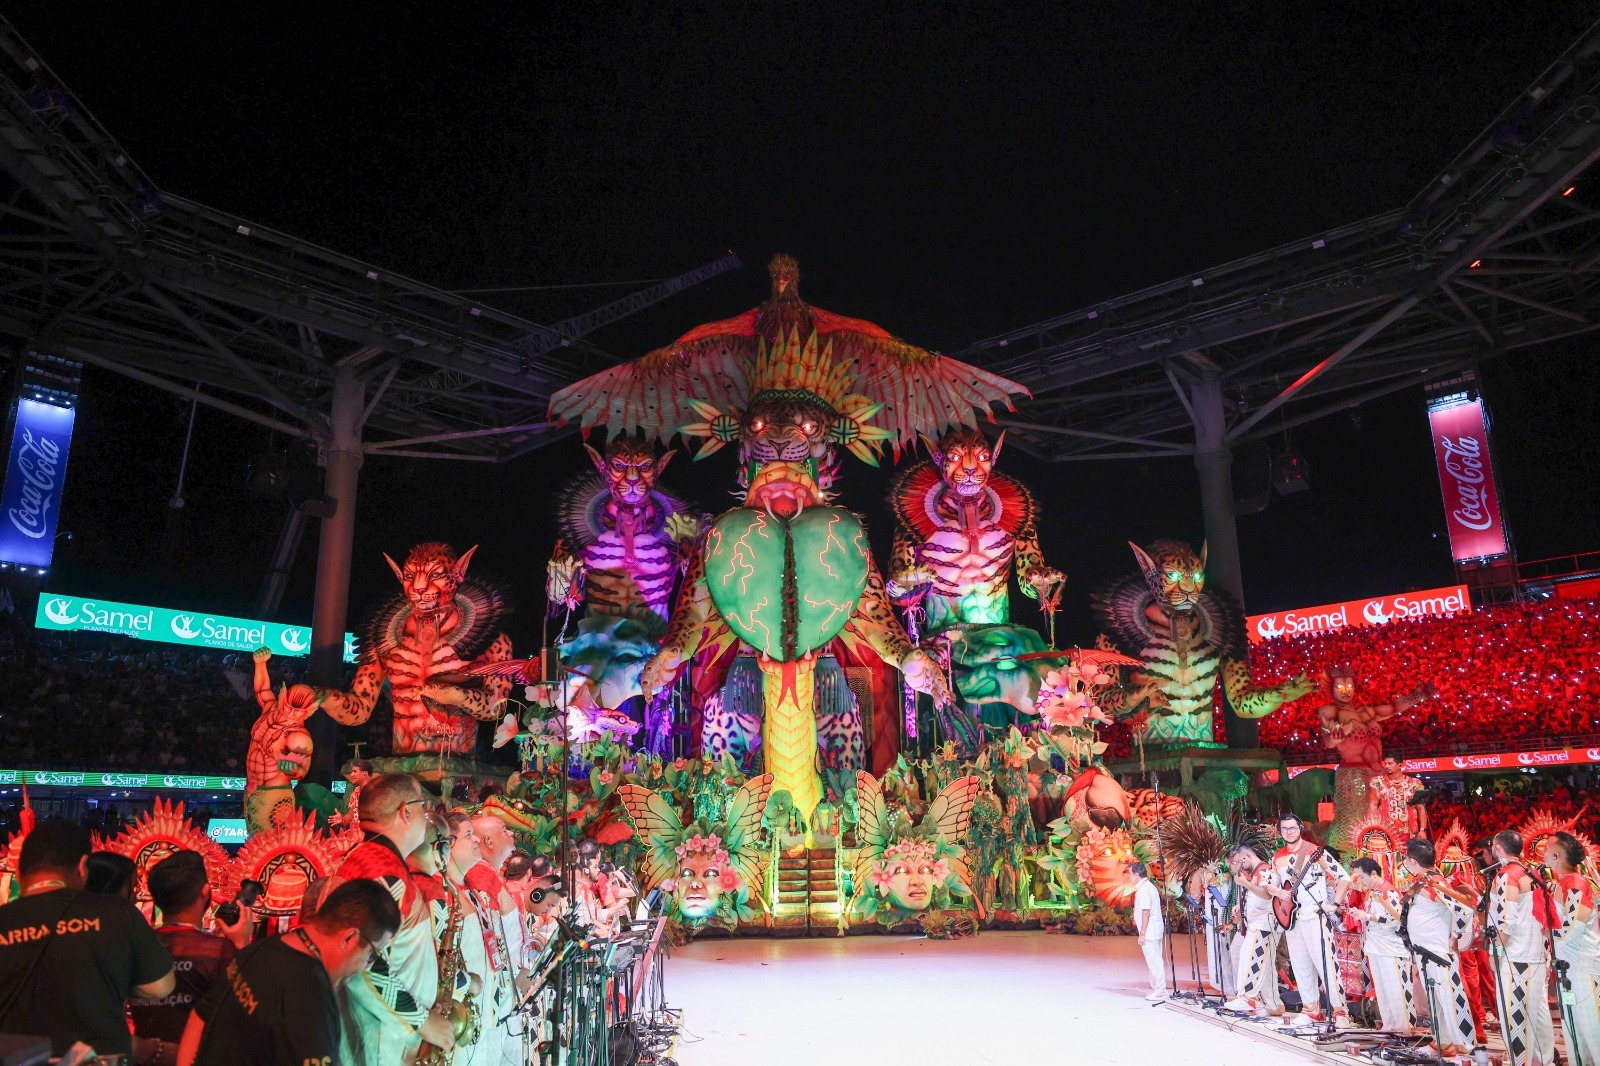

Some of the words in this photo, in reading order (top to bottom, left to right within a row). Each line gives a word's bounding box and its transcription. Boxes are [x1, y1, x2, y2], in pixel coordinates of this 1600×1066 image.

[1394, 588, 1465, 619] Samel
[80, 602, 153, 631] Samel
[1284, 605, 1347, 634] Samel
[201, 617, 266, 645] Samel
[204, 638, 227, 647] PLANOS
[1467, 754, 1501, 766] Samel
[1533, 750, 1569, 762] Samel
[1405, 758, 1437, 770] Samel
[50, 772, 85, 784] Samel
[116, 774, 148, 785] Samel
[177, 776, 207, 787] Samel
[56, 918, 100, 935] SOM
